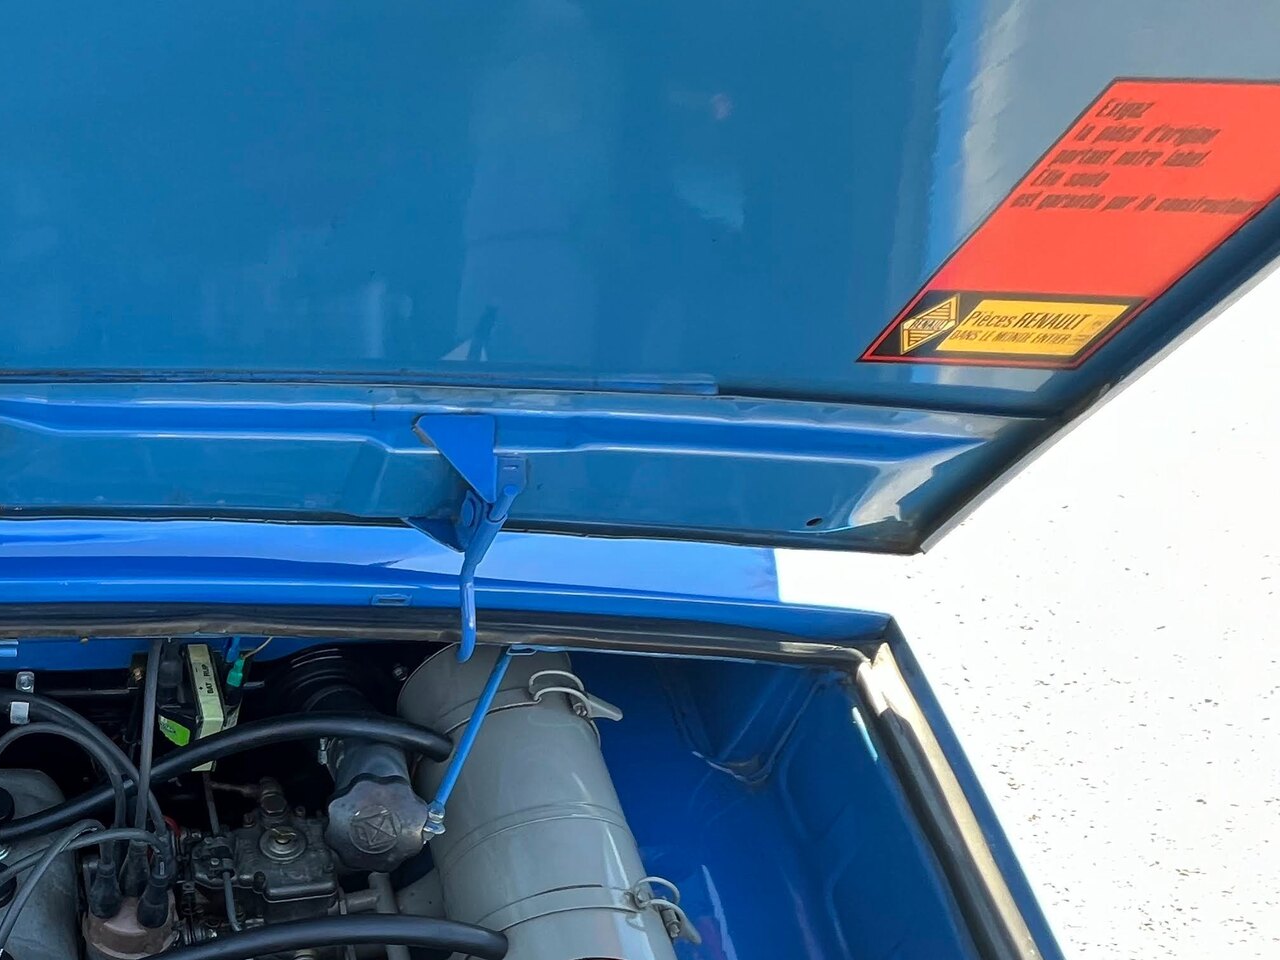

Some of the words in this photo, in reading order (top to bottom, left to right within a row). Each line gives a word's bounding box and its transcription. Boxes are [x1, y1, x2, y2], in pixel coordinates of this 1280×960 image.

[909, 318, 951, 330] RENAULT
[961, 311, 1017, 328] Pièces
[1012, 312, 1092, 330] RENAULT
[949, 330, 982, 340] DANS
[979, 330, 996, 341] LE
[992, 331, 1034, 343] MONDE
